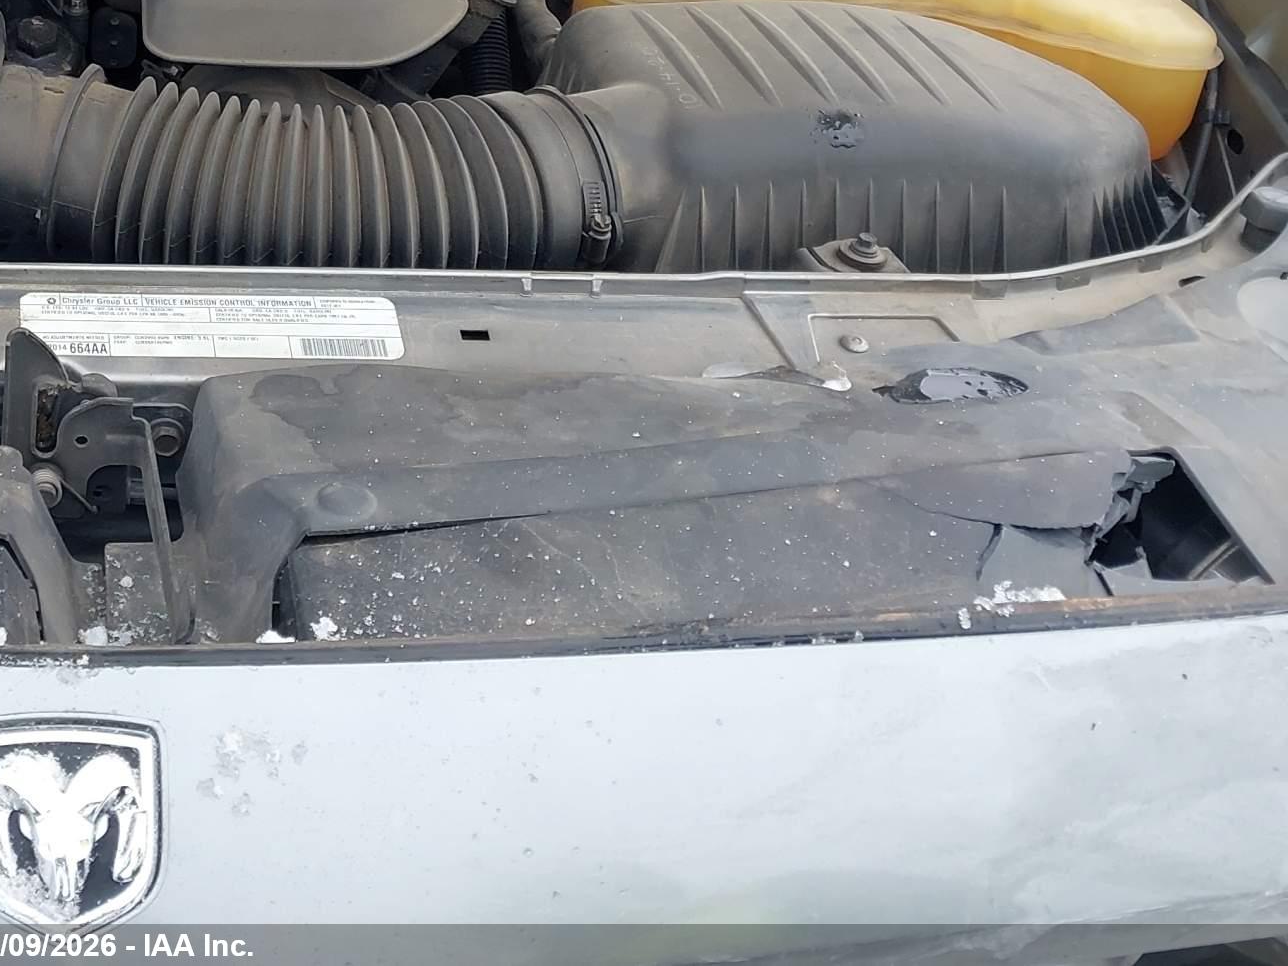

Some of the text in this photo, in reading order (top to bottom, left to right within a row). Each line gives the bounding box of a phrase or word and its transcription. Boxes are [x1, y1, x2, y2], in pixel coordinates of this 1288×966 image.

[62, 297, 139, 306] Chrysler Group LLC
[144, 298, 177, 306] VEHICLE
[179, 298, 217, 306] EMISSION
[219, 299, 254, 307] CONTROL
[257, 299, 312, 307] INFORMATION
[69, 342, 108, 354] 664AA
